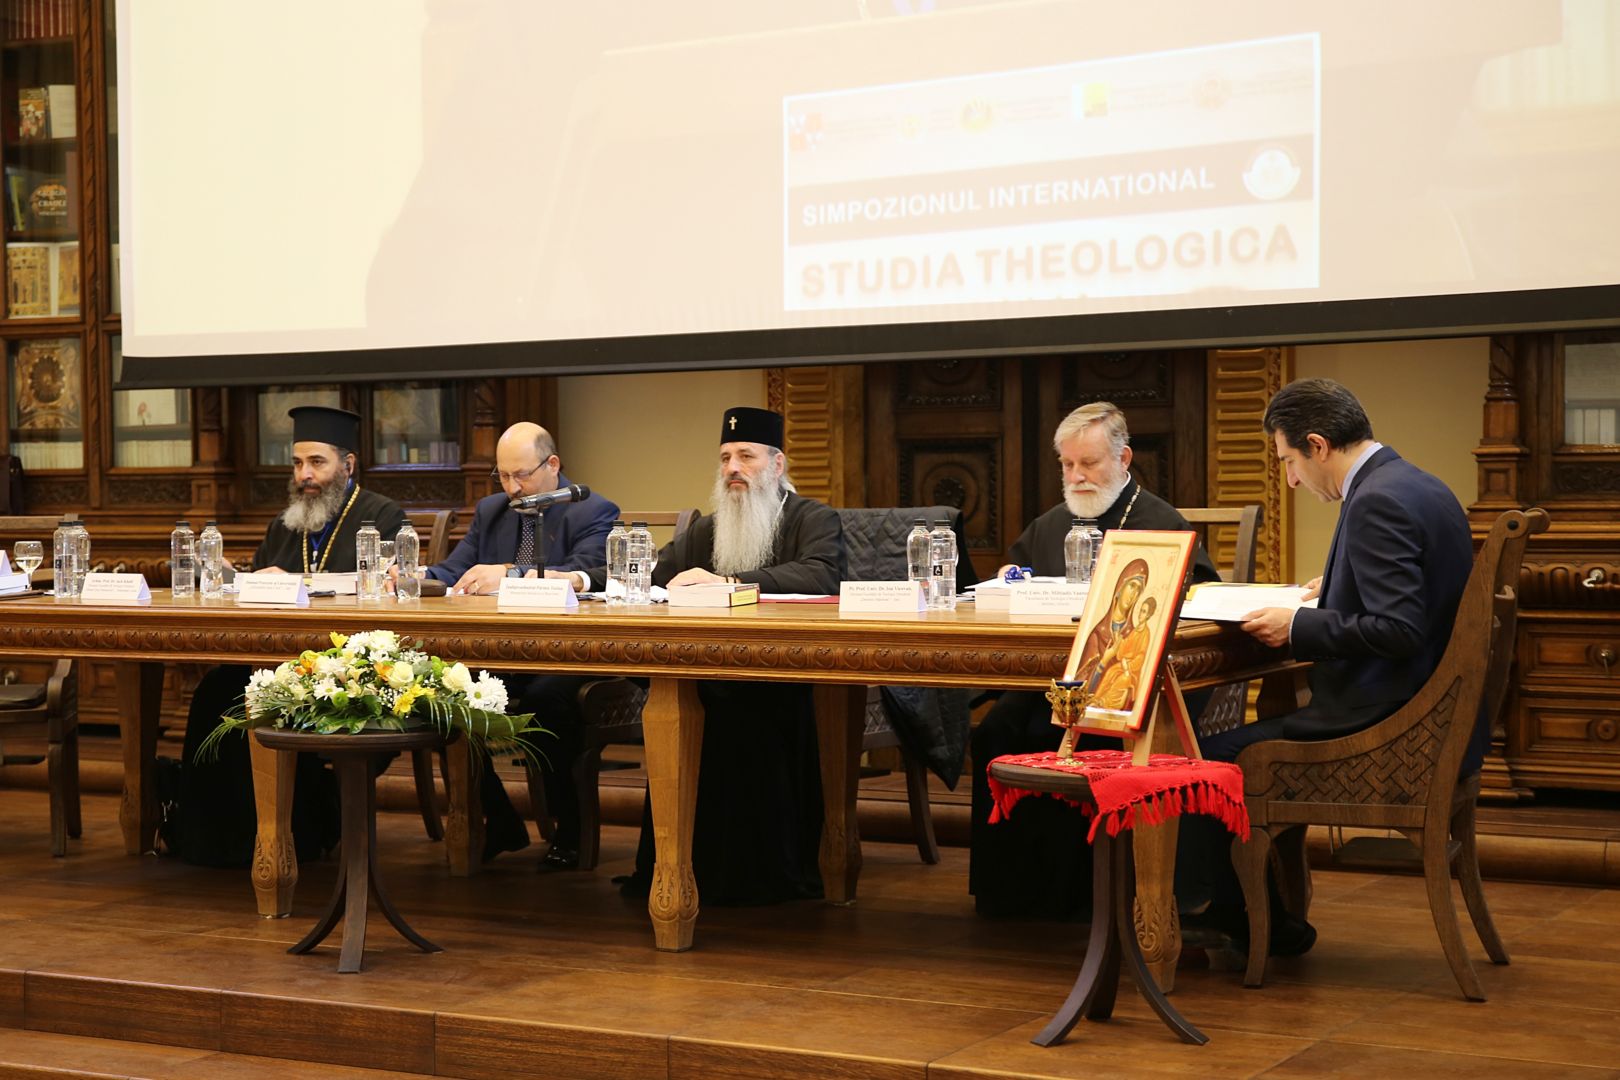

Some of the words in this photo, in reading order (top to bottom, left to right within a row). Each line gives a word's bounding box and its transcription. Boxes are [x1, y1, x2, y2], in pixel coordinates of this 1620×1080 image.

[802, 188, 981, 227] SIMPOZIONUL
[988, 165, 1216, 209] INTERNAȚIONAL
[801, 253, 966, 300] STUDIA
[976, 223, 1299, 286] THEOLOGICA
